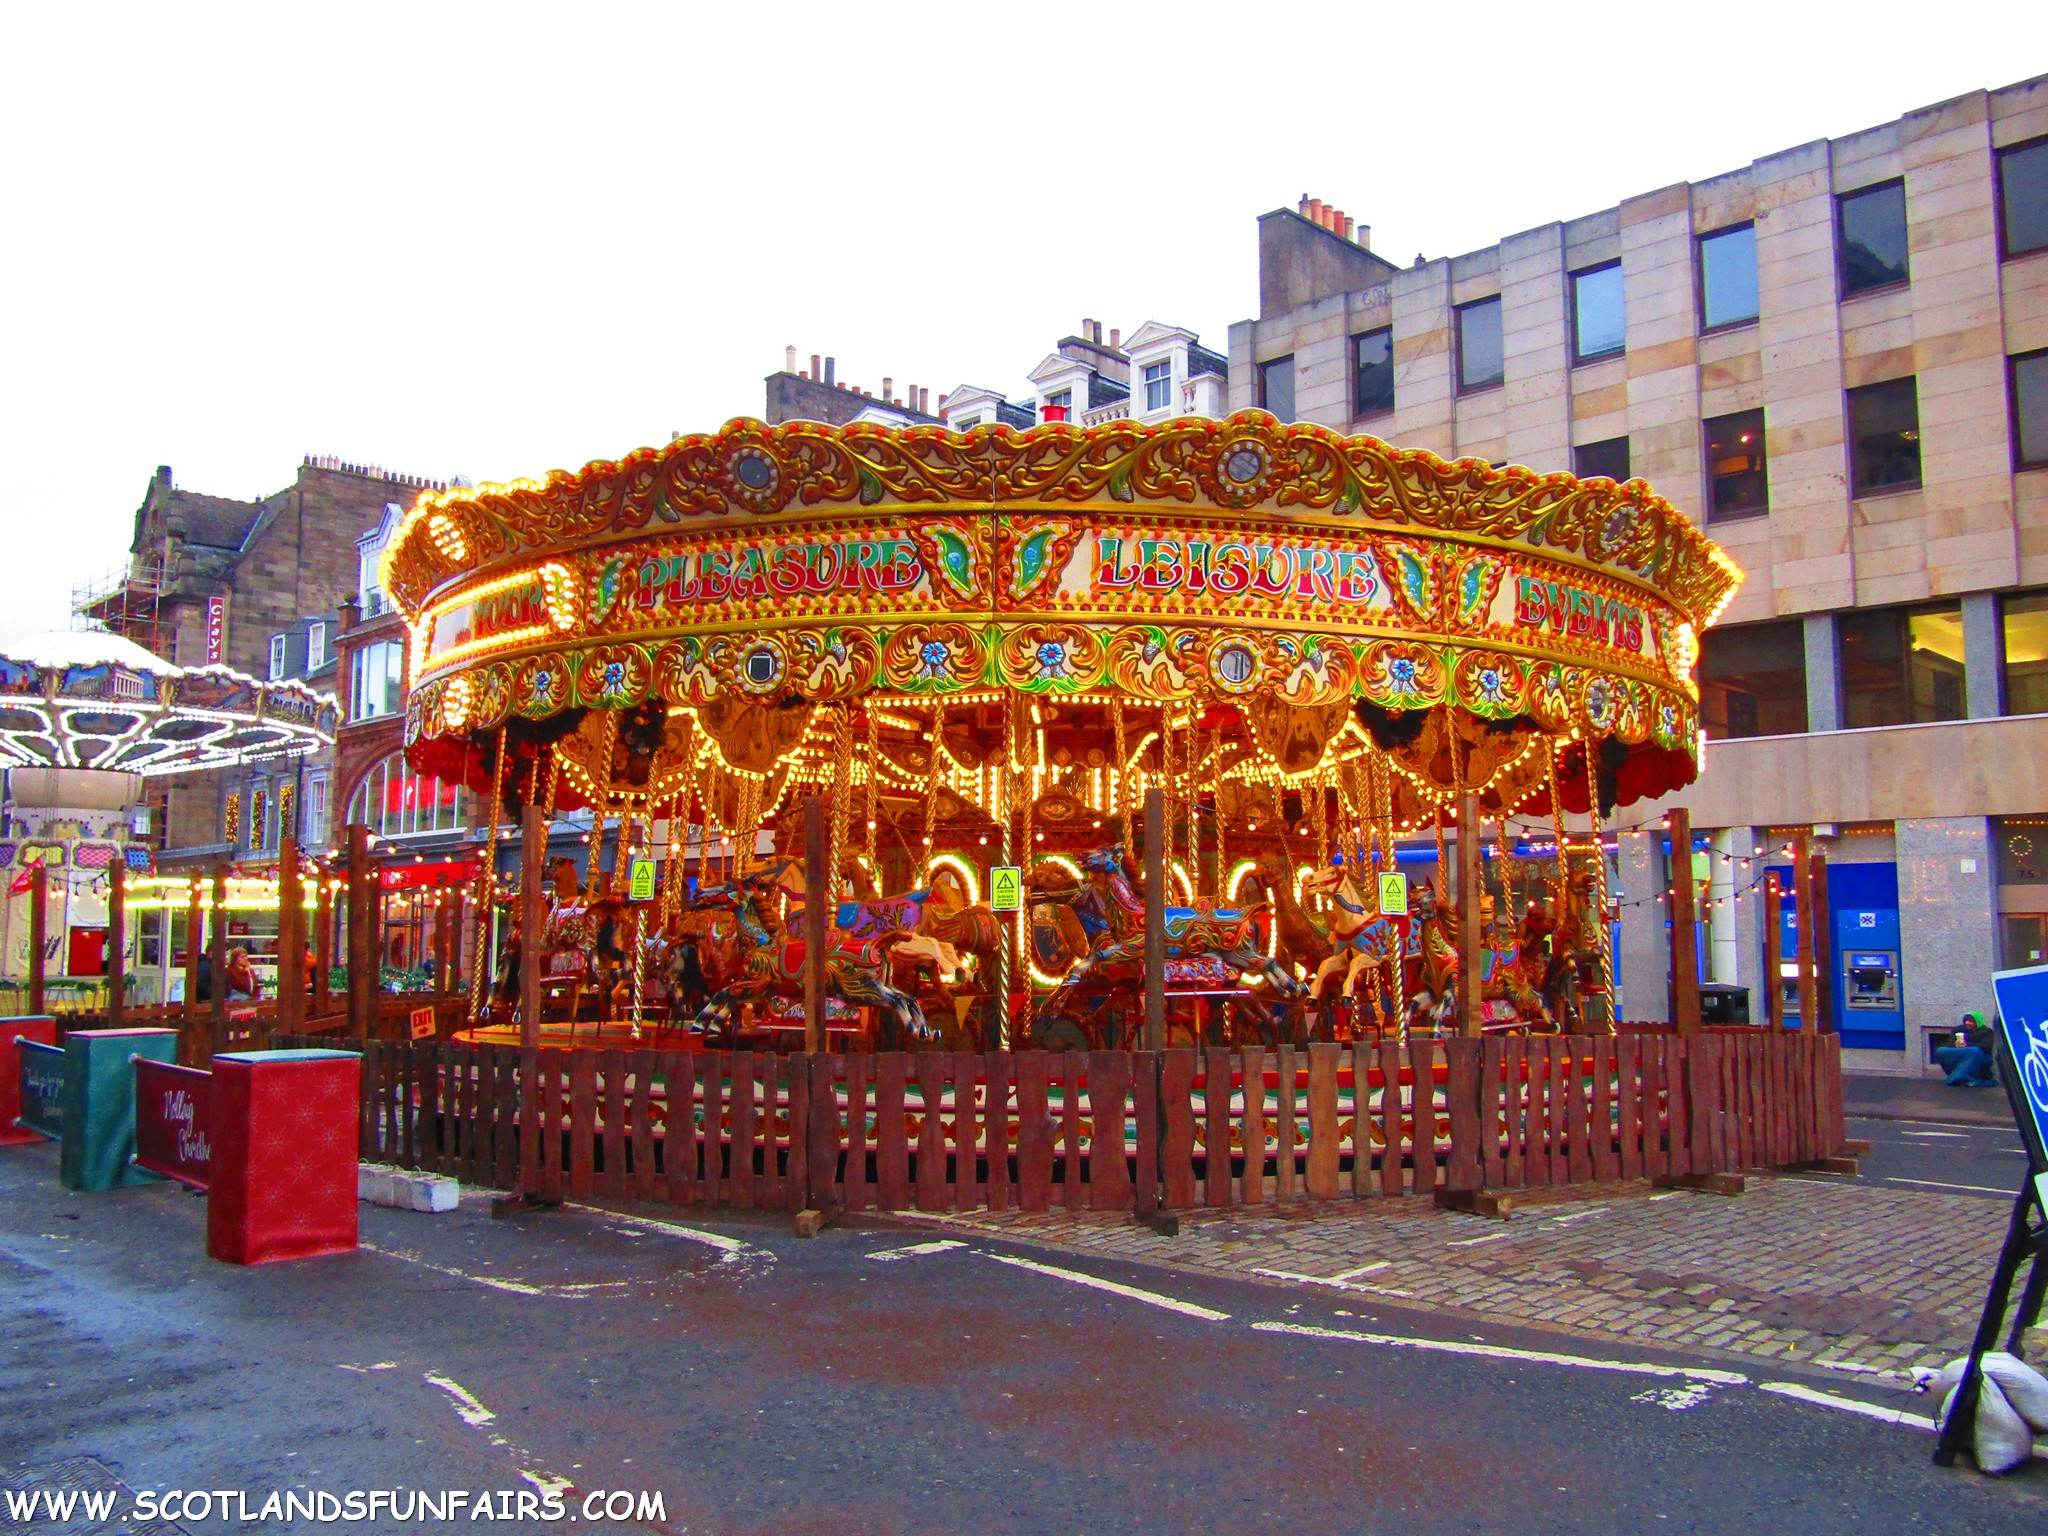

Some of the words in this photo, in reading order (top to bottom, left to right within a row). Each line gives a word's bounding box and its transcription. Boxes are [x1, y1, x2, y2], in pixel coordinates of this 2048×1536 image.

[638, 539, 924, 608] PLEASURE
[1091, 537, 1377, 605] LEISURE
[209, 604, 222, 659] Grays
[474, 582, 549, 638] YOUR
[1516, 576, 1643, 652] EVENTS
[413, 1009, 432, 1028] EXIT
